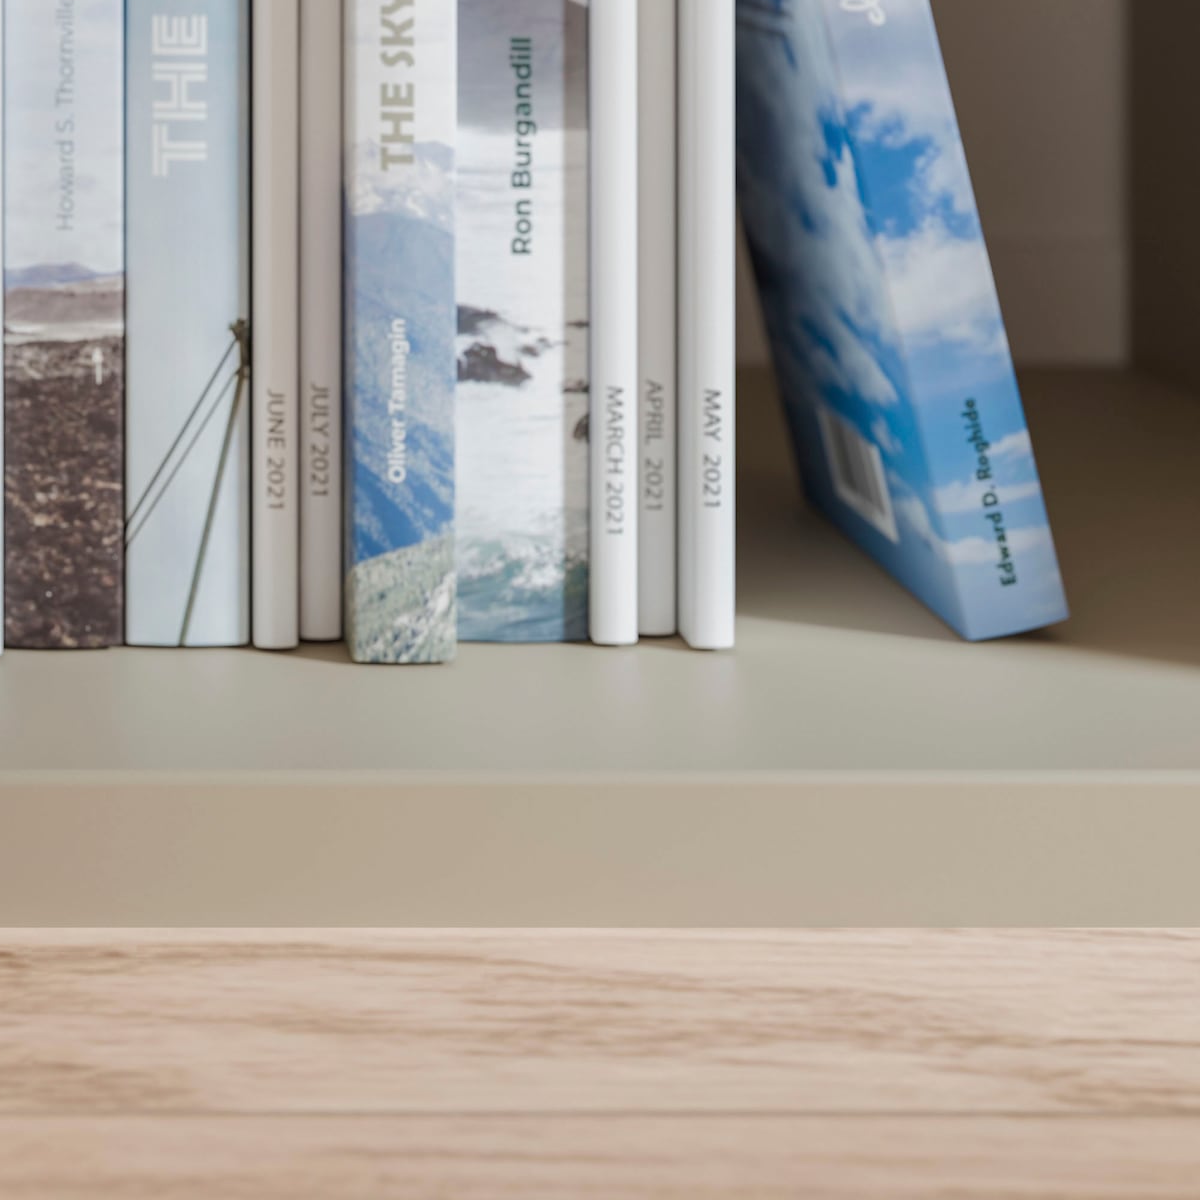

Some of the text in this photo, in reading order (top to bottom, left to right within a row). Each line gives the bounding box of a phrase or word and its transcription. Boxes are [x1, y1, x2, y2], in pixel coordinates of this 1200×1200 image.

[56, 113, 75, 132] S.
[150, 14, 208, 178] THE
[379, 82, 416, 172] THE
[509, 36, 537, 255] Ron Burgandill
[56, 140, 75, 232] Howard
[266, 388, 286, 511] JUNE 2021
[309, 381, 330, 498] JULY 2021
[387, 317, 411, 484] Oliver Tamagin
[605, 385, 624, 536] MARCH 2021
[645, 379, 664, 512] APRIL 2021
[703, 388, 722, 508] MAY 2021
[961, 398, 1017, 587] Edward D. Roghide
